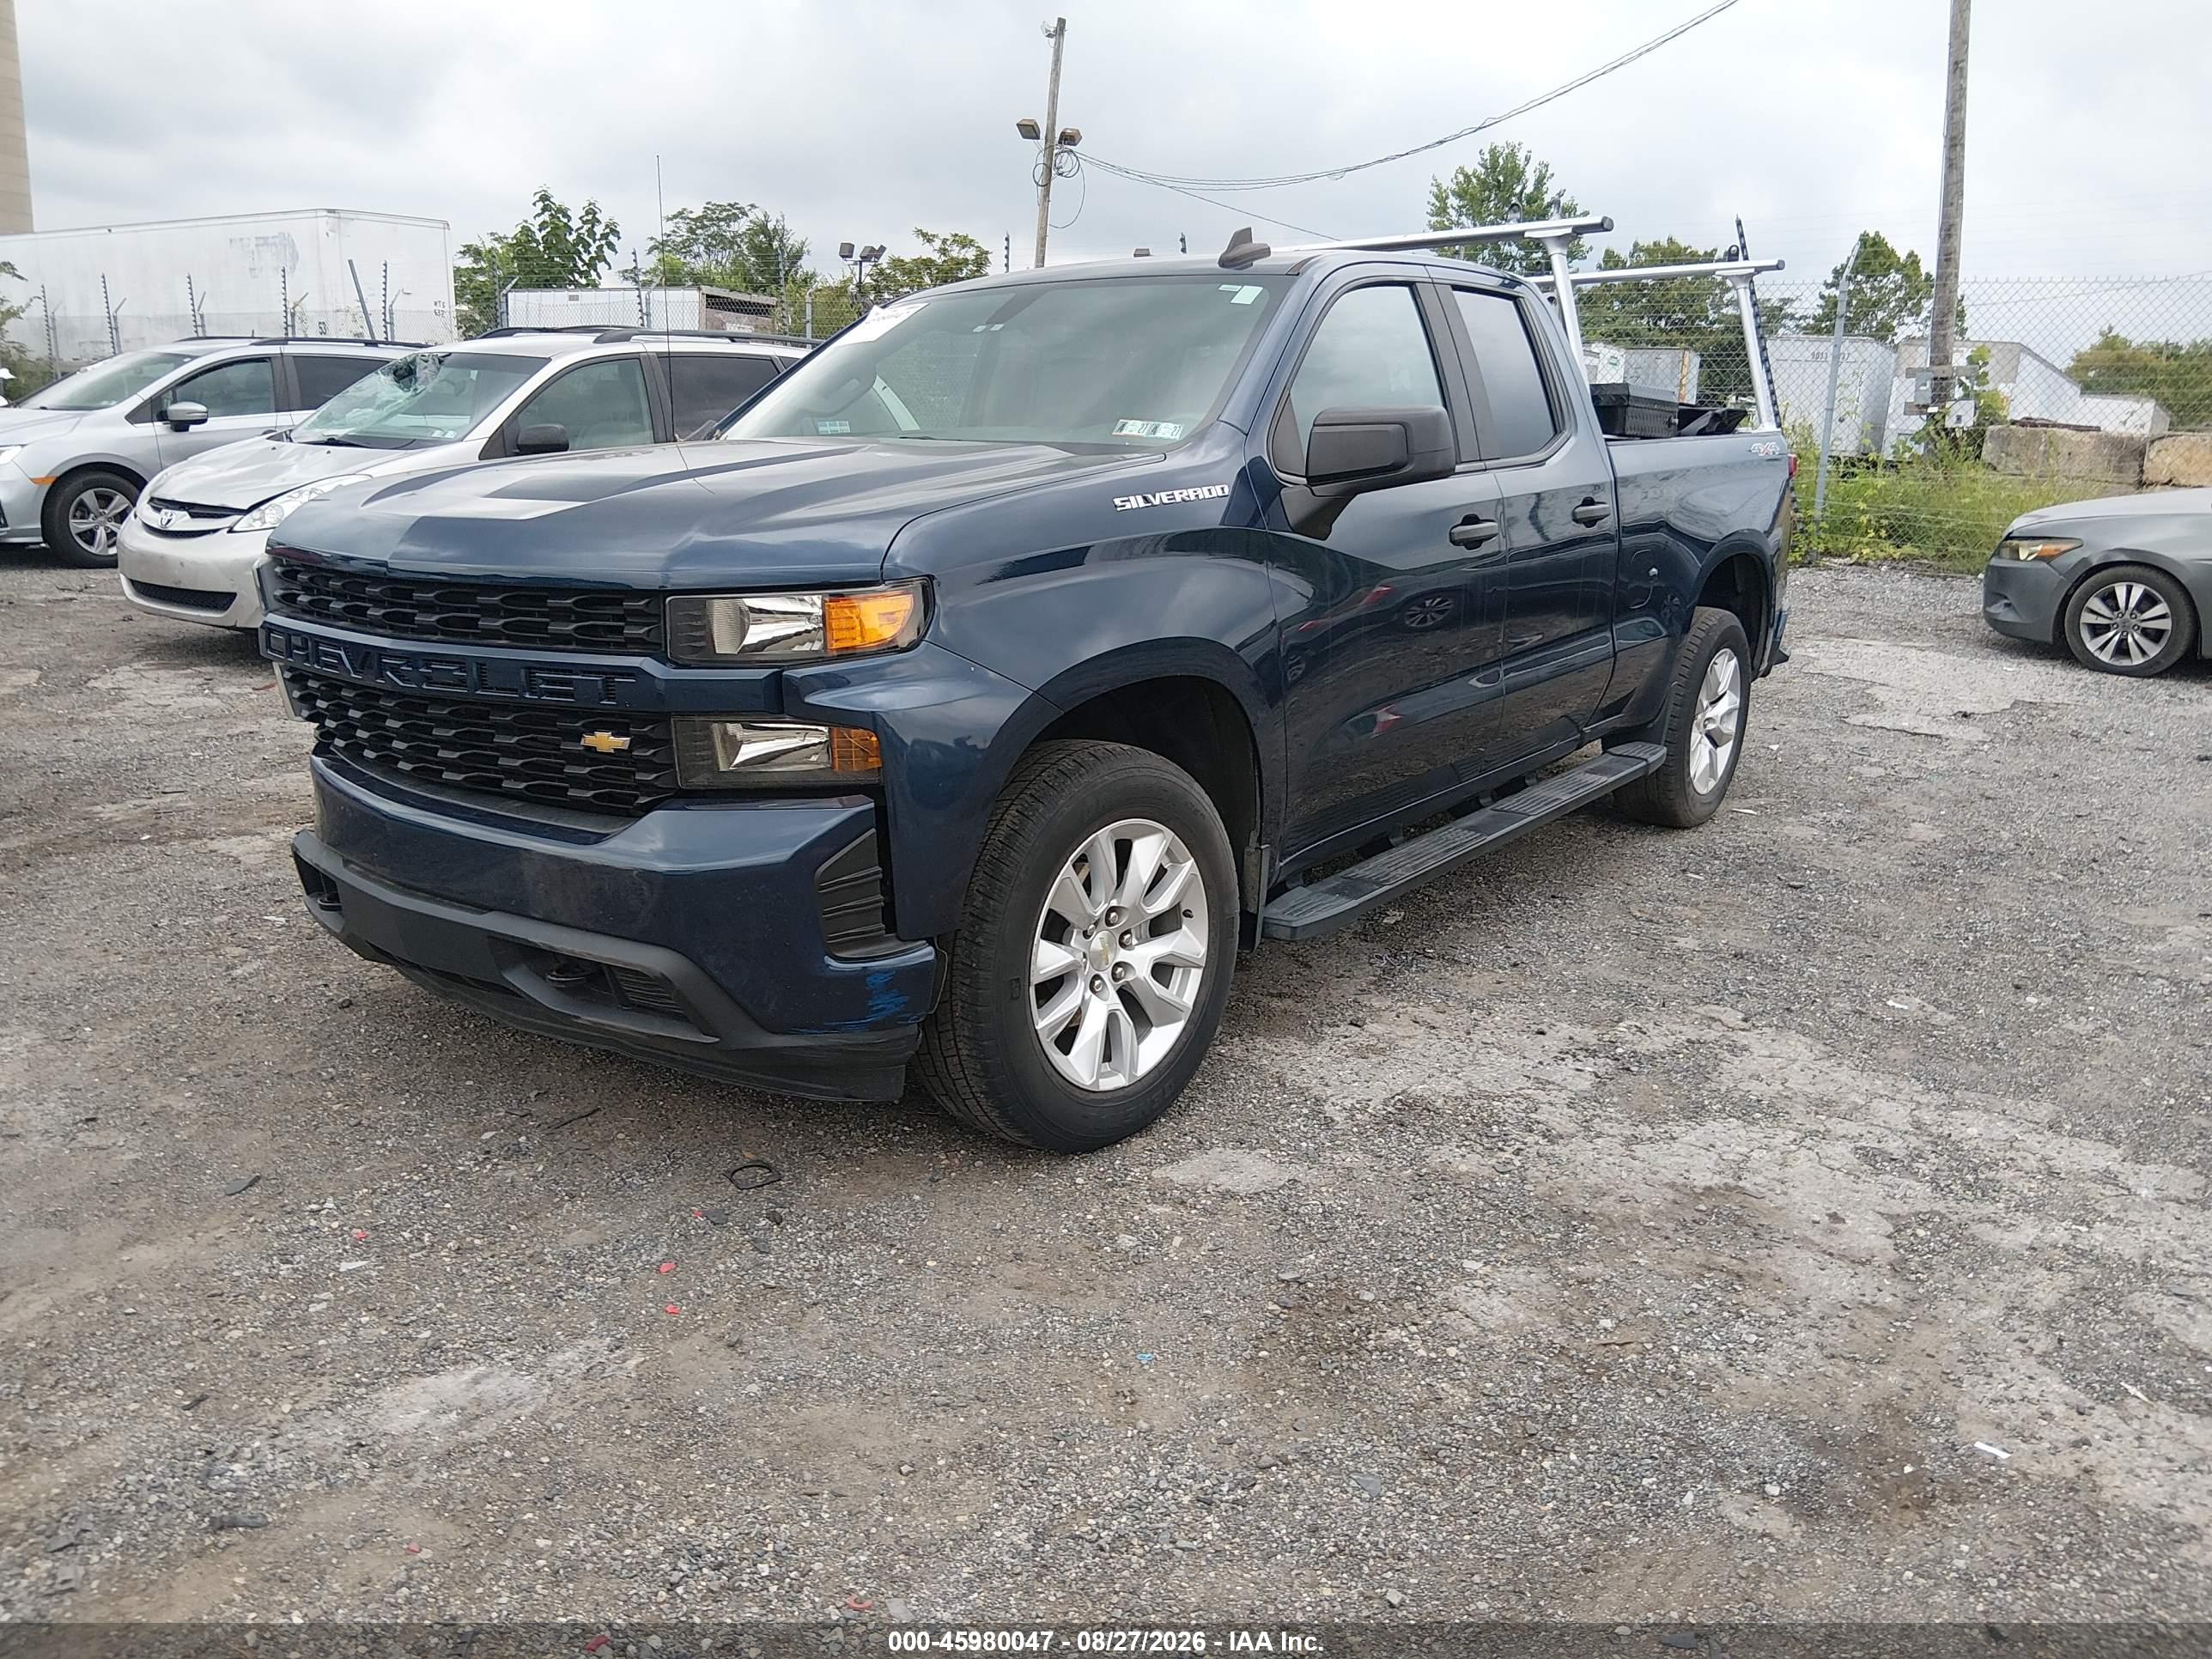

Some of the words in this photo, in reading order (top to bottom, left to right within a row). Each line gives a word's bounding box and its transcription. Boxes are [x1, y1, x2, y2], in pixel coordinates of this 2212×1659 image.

[318, 321, 327, 335] 53
[1138, 423, 1150, 434] 27
[1170, 426, 1182, 437] 27
[1113, 484, 1230, 512] SILVERADO
[265, 629, 637, 705] CHEVROLET
